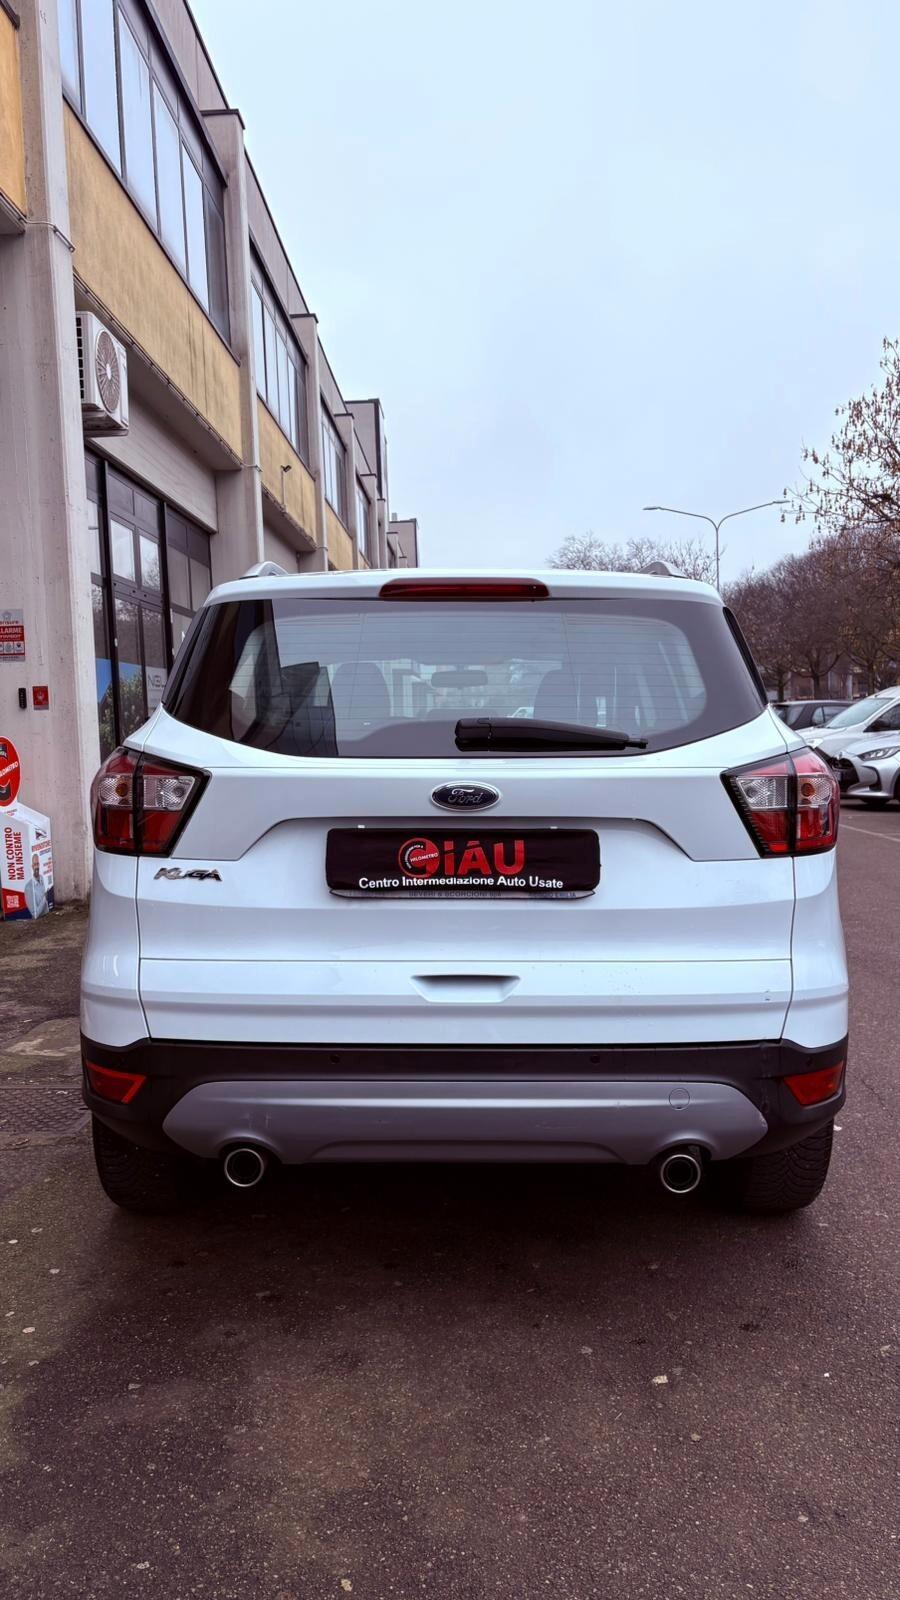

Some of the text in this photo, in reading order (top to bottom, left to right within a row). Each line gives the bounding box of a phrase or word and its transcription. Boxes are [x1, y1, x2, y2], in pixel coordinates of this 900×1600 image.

[447, 788, 483, 804] Ford
[4, 827, 15, 859] CONTRO
[13, 831, 25, 880] MA INSIEME
[8, 862, 16, 880] NON
[358, 875, 564, 889] Centro Intermediazione Auto Usate
